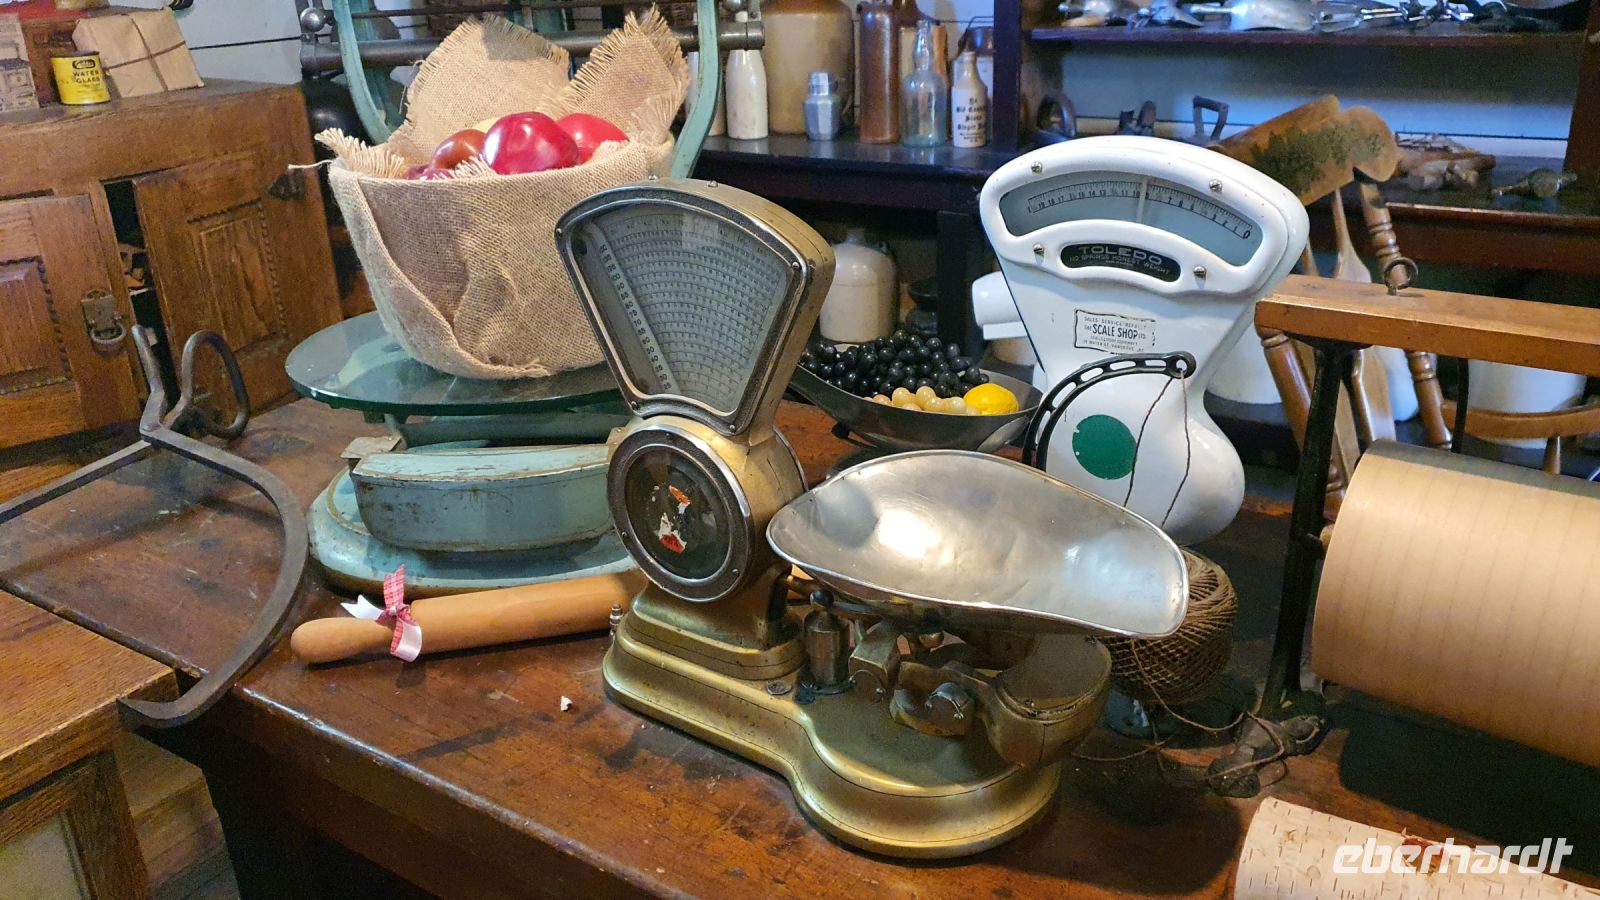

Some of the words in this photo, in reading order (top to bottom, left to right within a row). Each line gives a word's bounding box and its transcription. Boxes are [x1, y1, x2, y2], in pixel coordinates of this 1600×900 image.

[1079, 246, 1162, 265] TOLEDO
[1092, 323, 1115, 337] SCALE
[1117, 327, 1138, 340] SHOP
